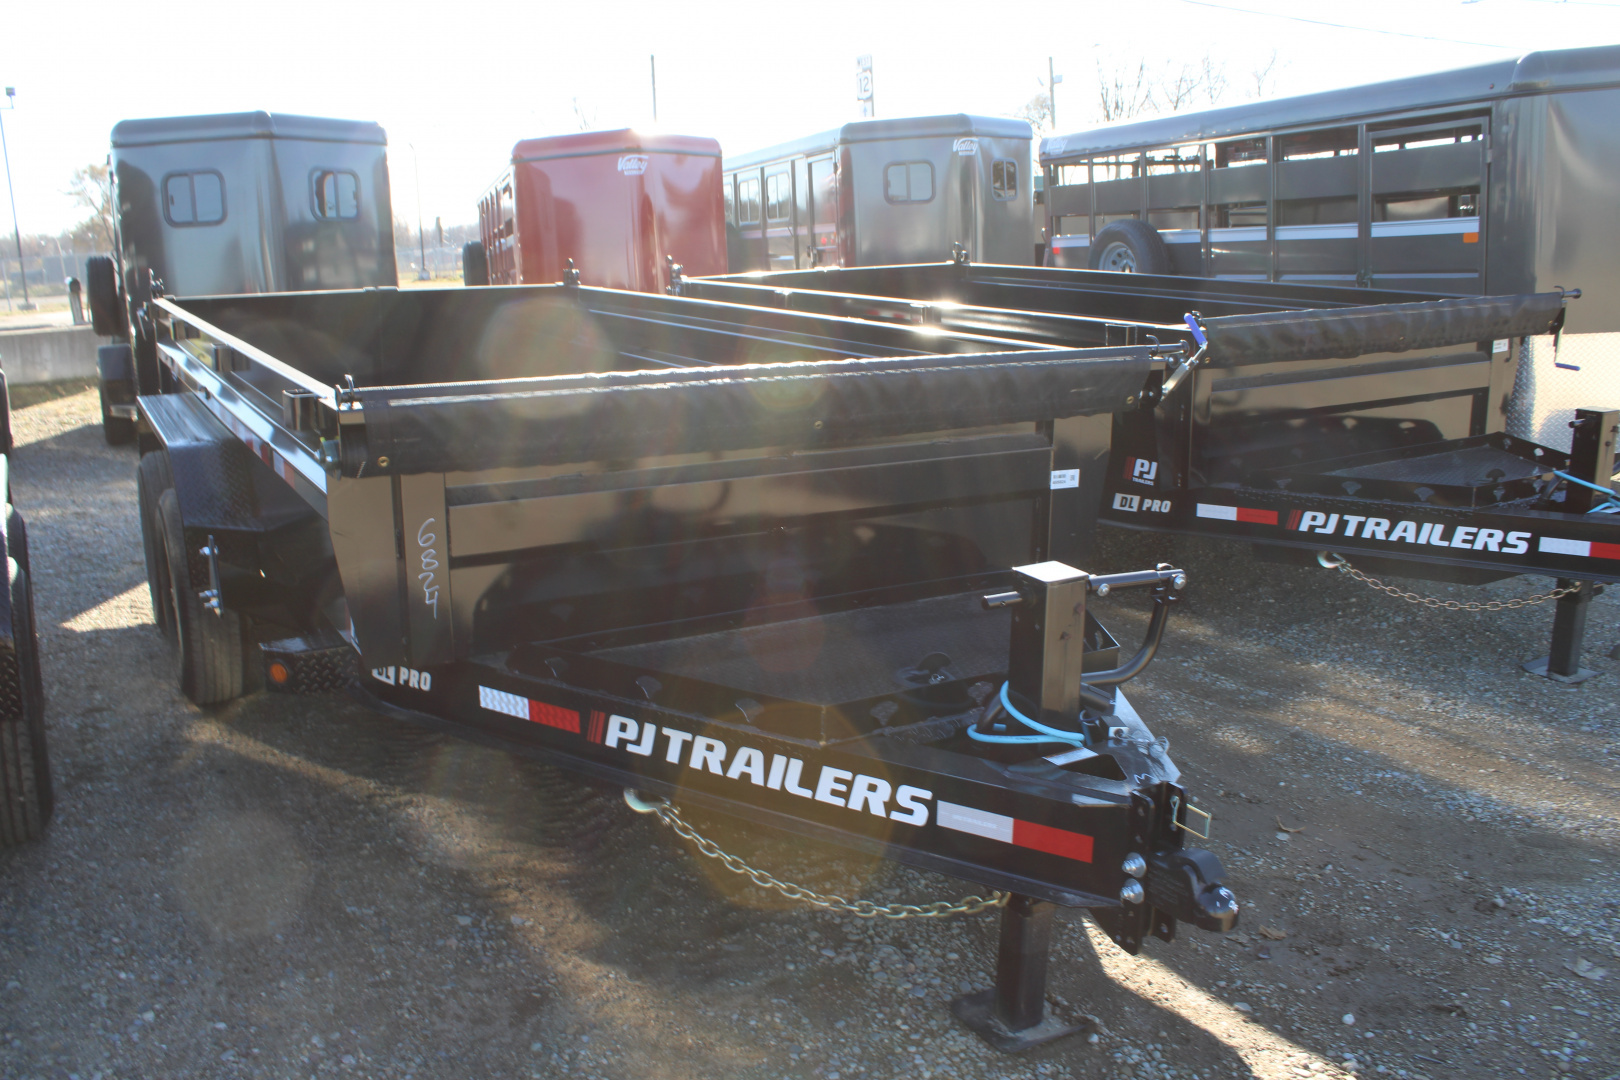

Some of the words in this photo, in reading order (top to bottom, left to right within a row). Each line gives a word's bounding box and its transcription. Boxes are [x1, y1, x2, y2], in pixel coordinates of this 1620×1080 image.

[859, 76, 870, 93] 12
[953, 137, 978, 156] Valley
[618, 154, 648, 174] Valley
[1133, 458, 1158, 480] PJ
[1132, 477, 1154, 486] TRAILERS
[1119, 496, 1134, 509] DL
[1141, 498, 1172, 513] PRO
[1298, 510, 1340, 534] PJ
[1343, 514, 1532, 555] TRAILERS
[418, 518, 440, 620] 6824
[398, 665, 432, 692] PRO
[604, 713, 657, 757] PJ
[661, 726, 934, 828] TRAILERS
